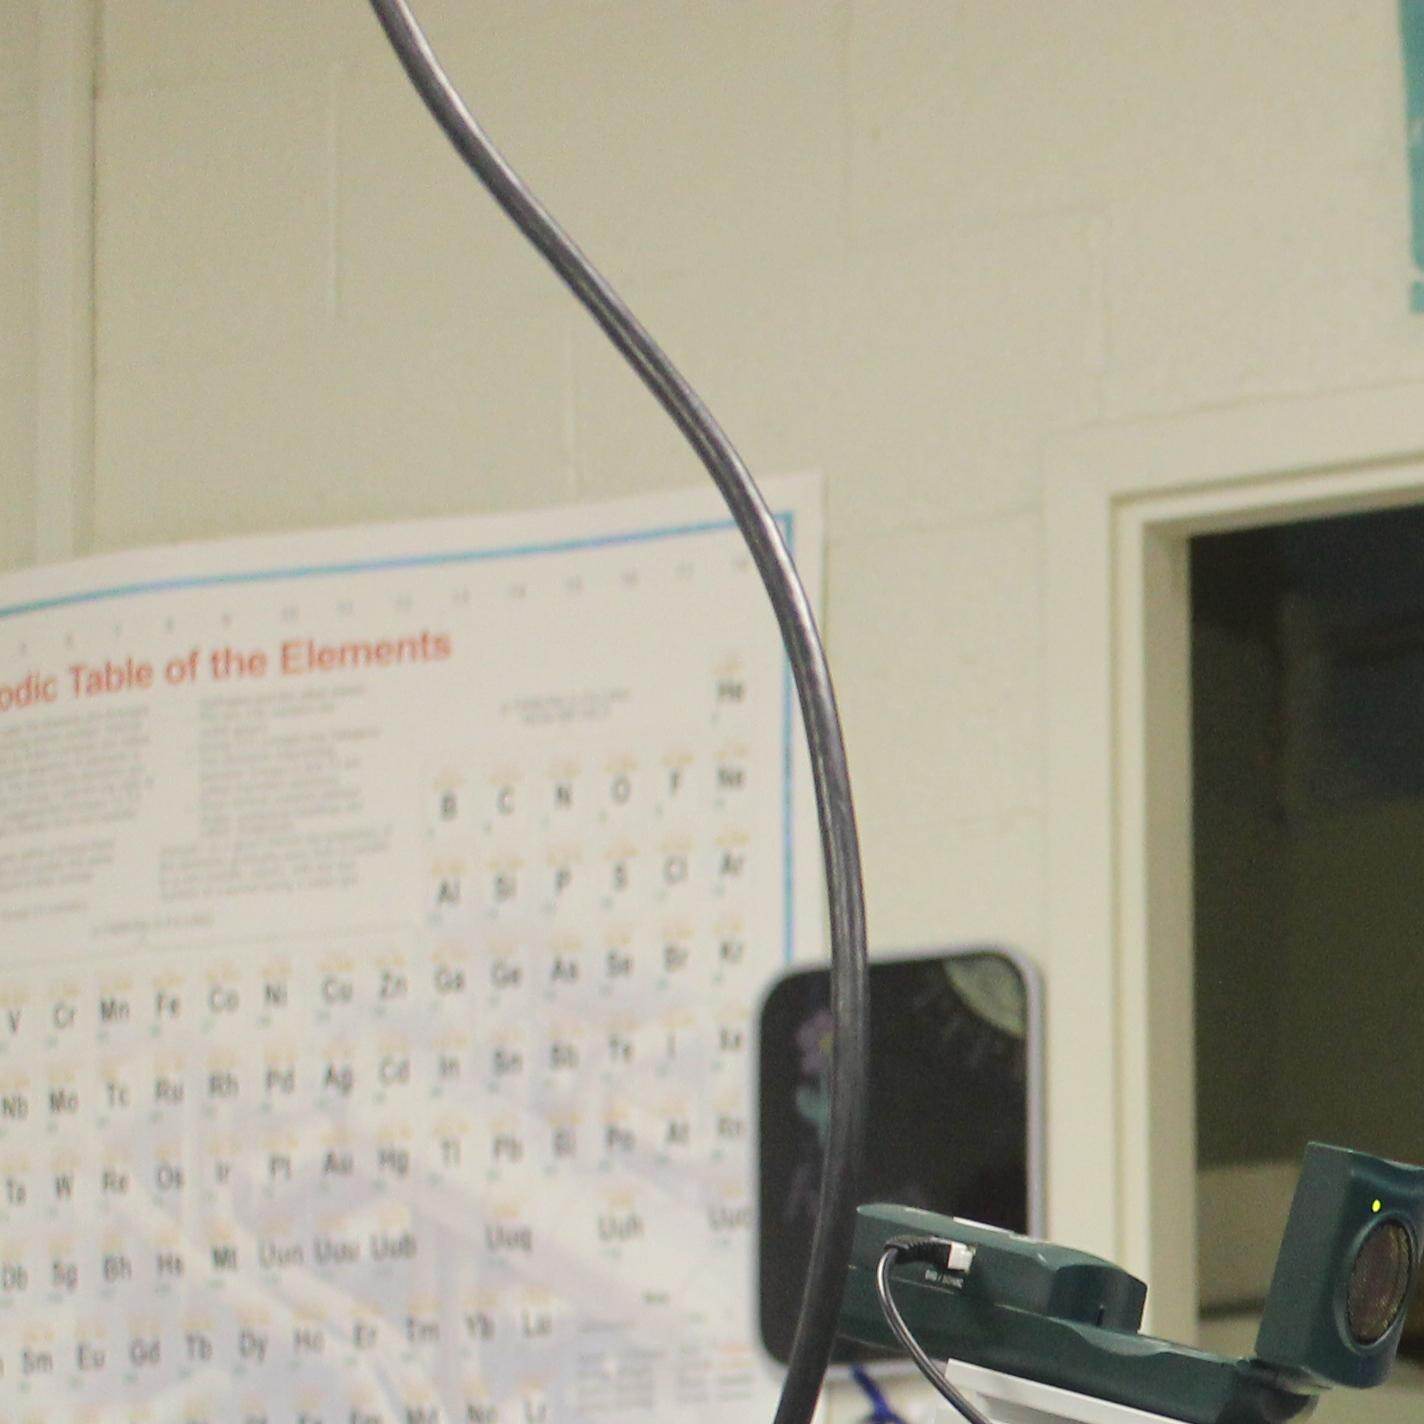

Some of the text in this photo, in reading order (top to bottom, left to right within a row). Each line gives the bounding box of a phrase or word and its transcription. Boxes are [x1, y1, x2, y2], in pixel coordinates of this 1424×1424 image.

[69, 656, 153, 699] Table
[164, 649, 200, 685] of
[210, 646, 267, 681] the
[280, 631, 452, 676] Elements
